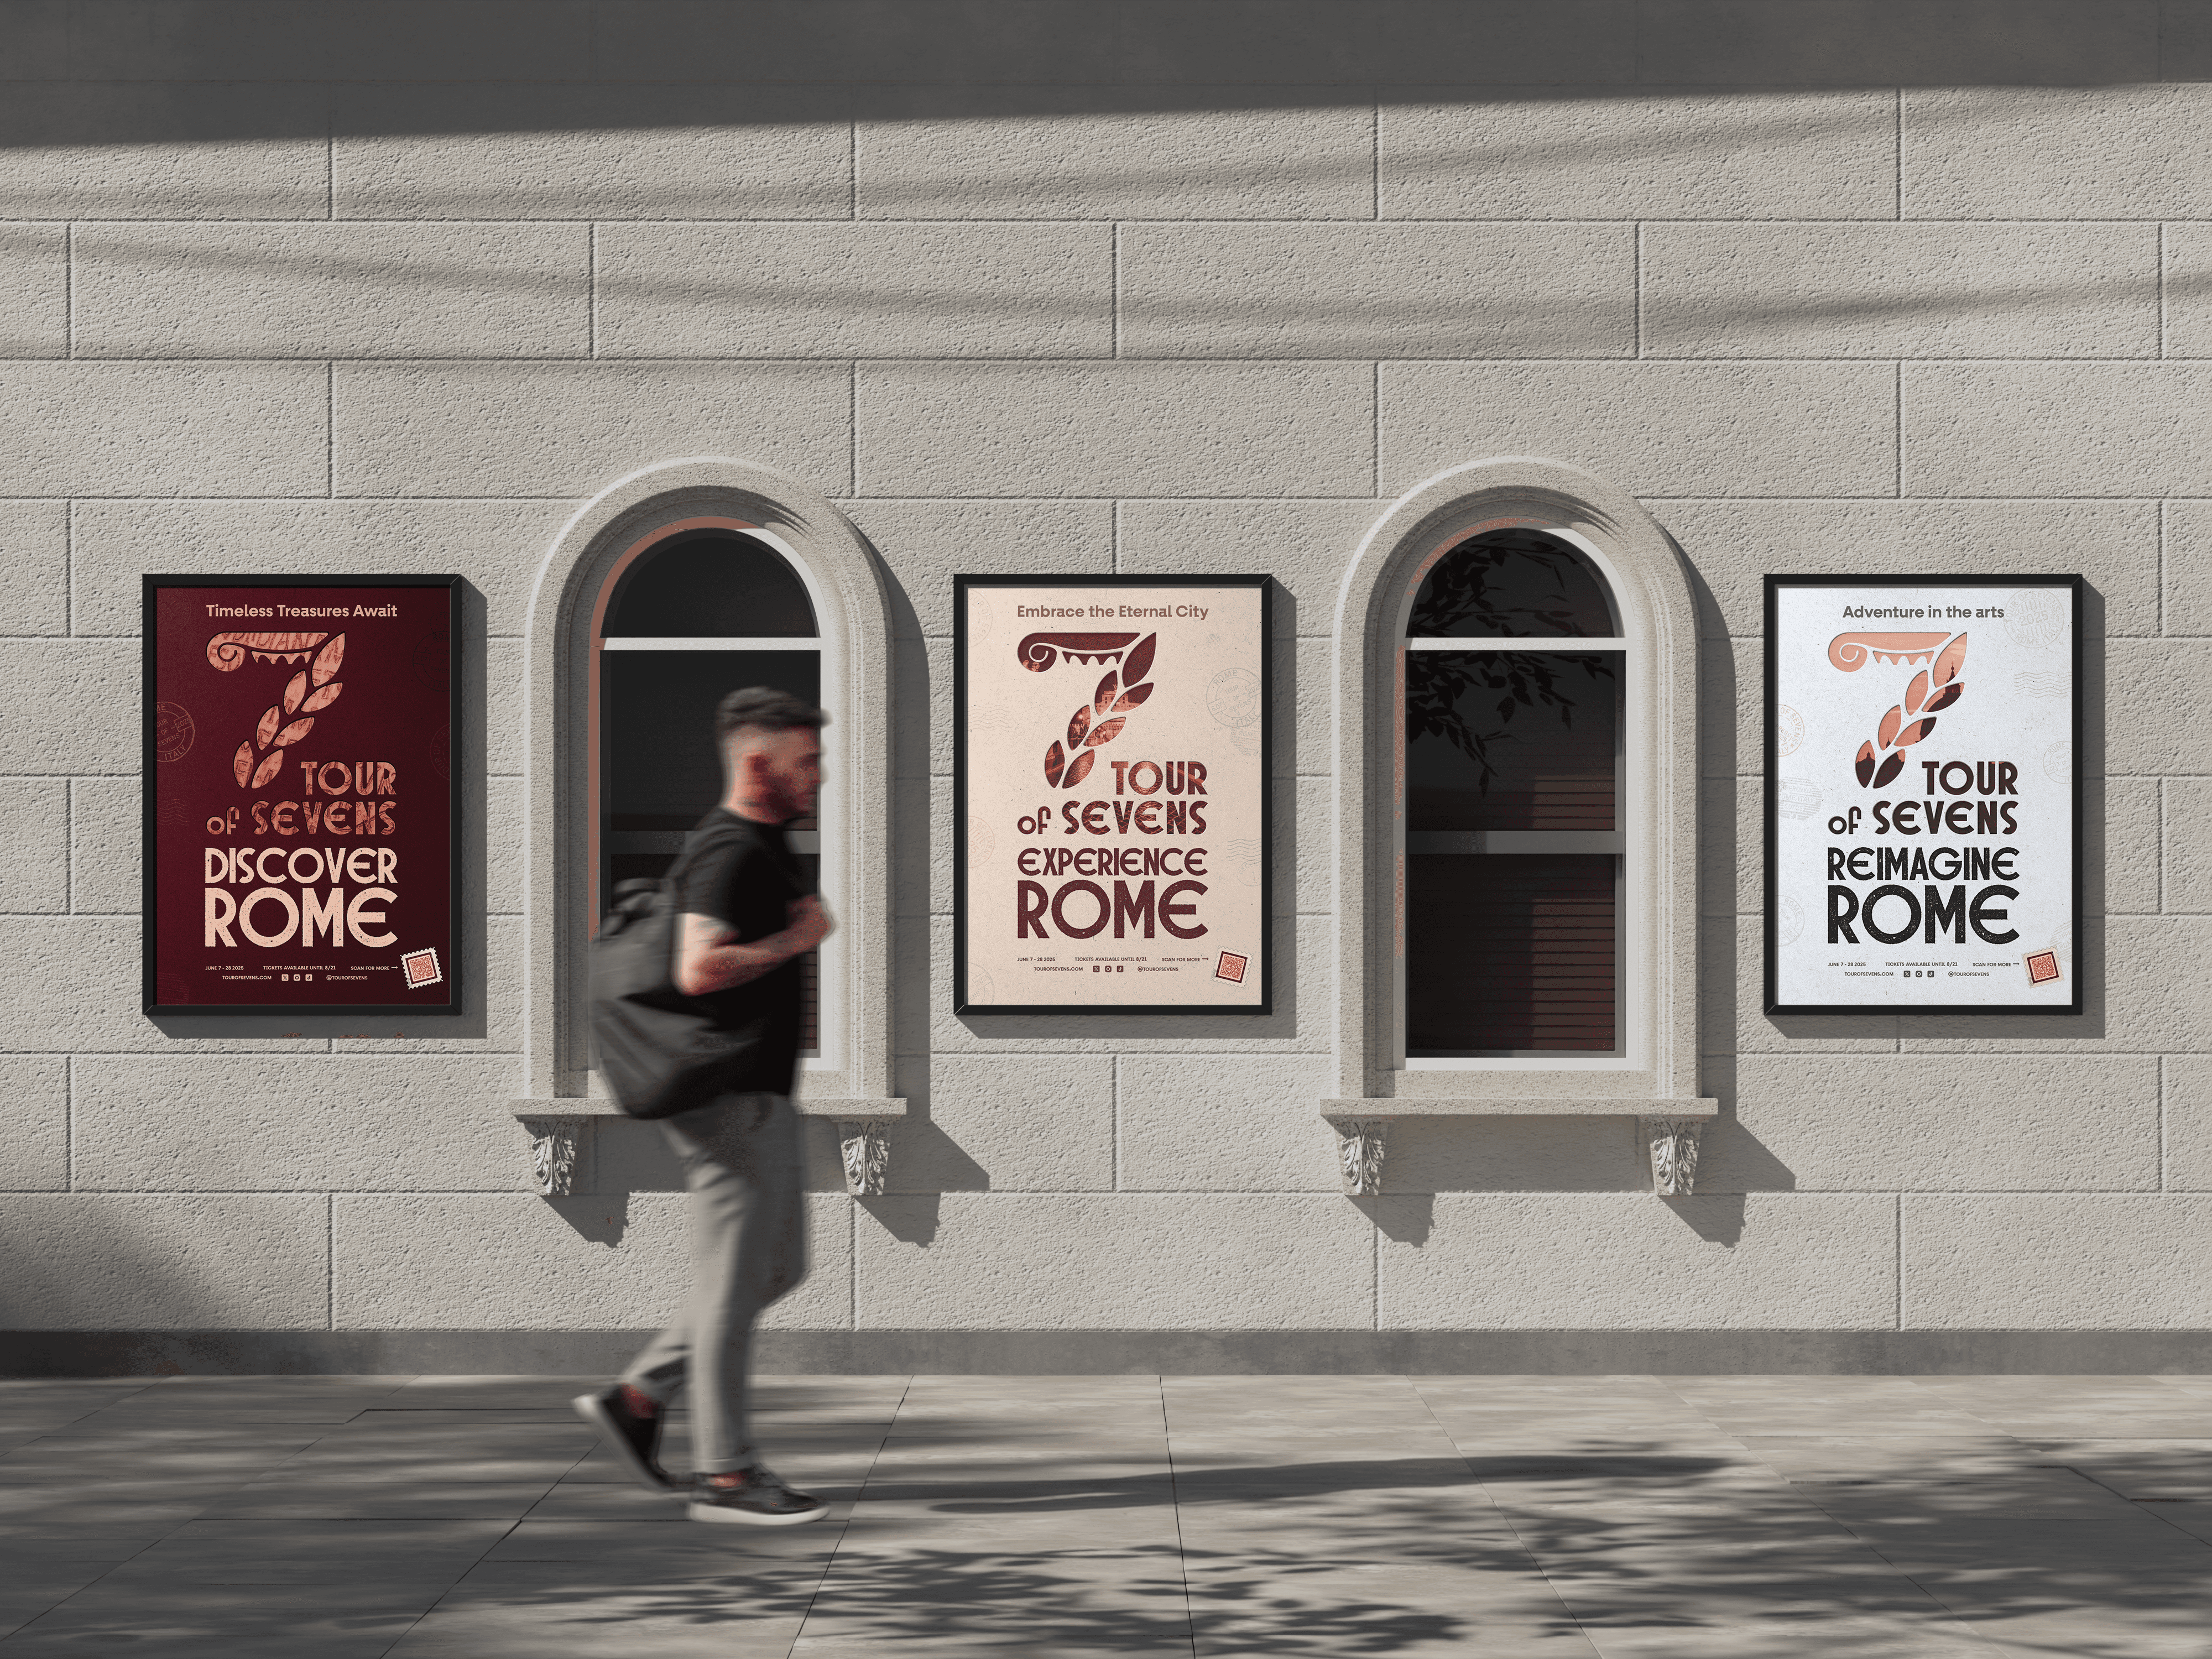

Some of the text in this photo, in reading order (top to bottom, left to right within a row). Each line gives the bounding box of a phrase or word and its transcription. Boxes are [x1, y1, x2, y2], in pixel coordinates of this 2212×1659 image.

[206, 604, 397, 617] Timeless Treasures Await
[1018, 604, 1209, 620] Embrace the Eternal City
[1843, 605, 2004, 618] Adventure in the arts
[2019, 610, 2049, 626] 2025
[1213, 669, 1238, 686] ROME
[157, 718, 168, 727] OUR
[176, 717, 190, 728] 2025
[158, 733, 180, 747] SEVENS
[165, 744, 186, 760] ITALY
[2048, 742, 2065, 754] ROME
[302, 762, 396, 795] TOUR
[1112, 761, 1207, 795] TOUR
[1923, 761, 2018, 795] TOUR
[207, 802, 396, 834] of SEVENS
[1019, 801, 1207, 834] of SEVENS
[1829, 801, 2018, 834] of SEVENS
[205, 847, 398, 884] DISCOVER
[1018, 848, 1208, 876] EXPERIENCE
[1828, 847, 2020, 881] REIMAGINE
[205, 887, 398, 947] ROME
[1018, 880, 1208, 939] ROME
[1828, 884, 2020, 945] ROME
